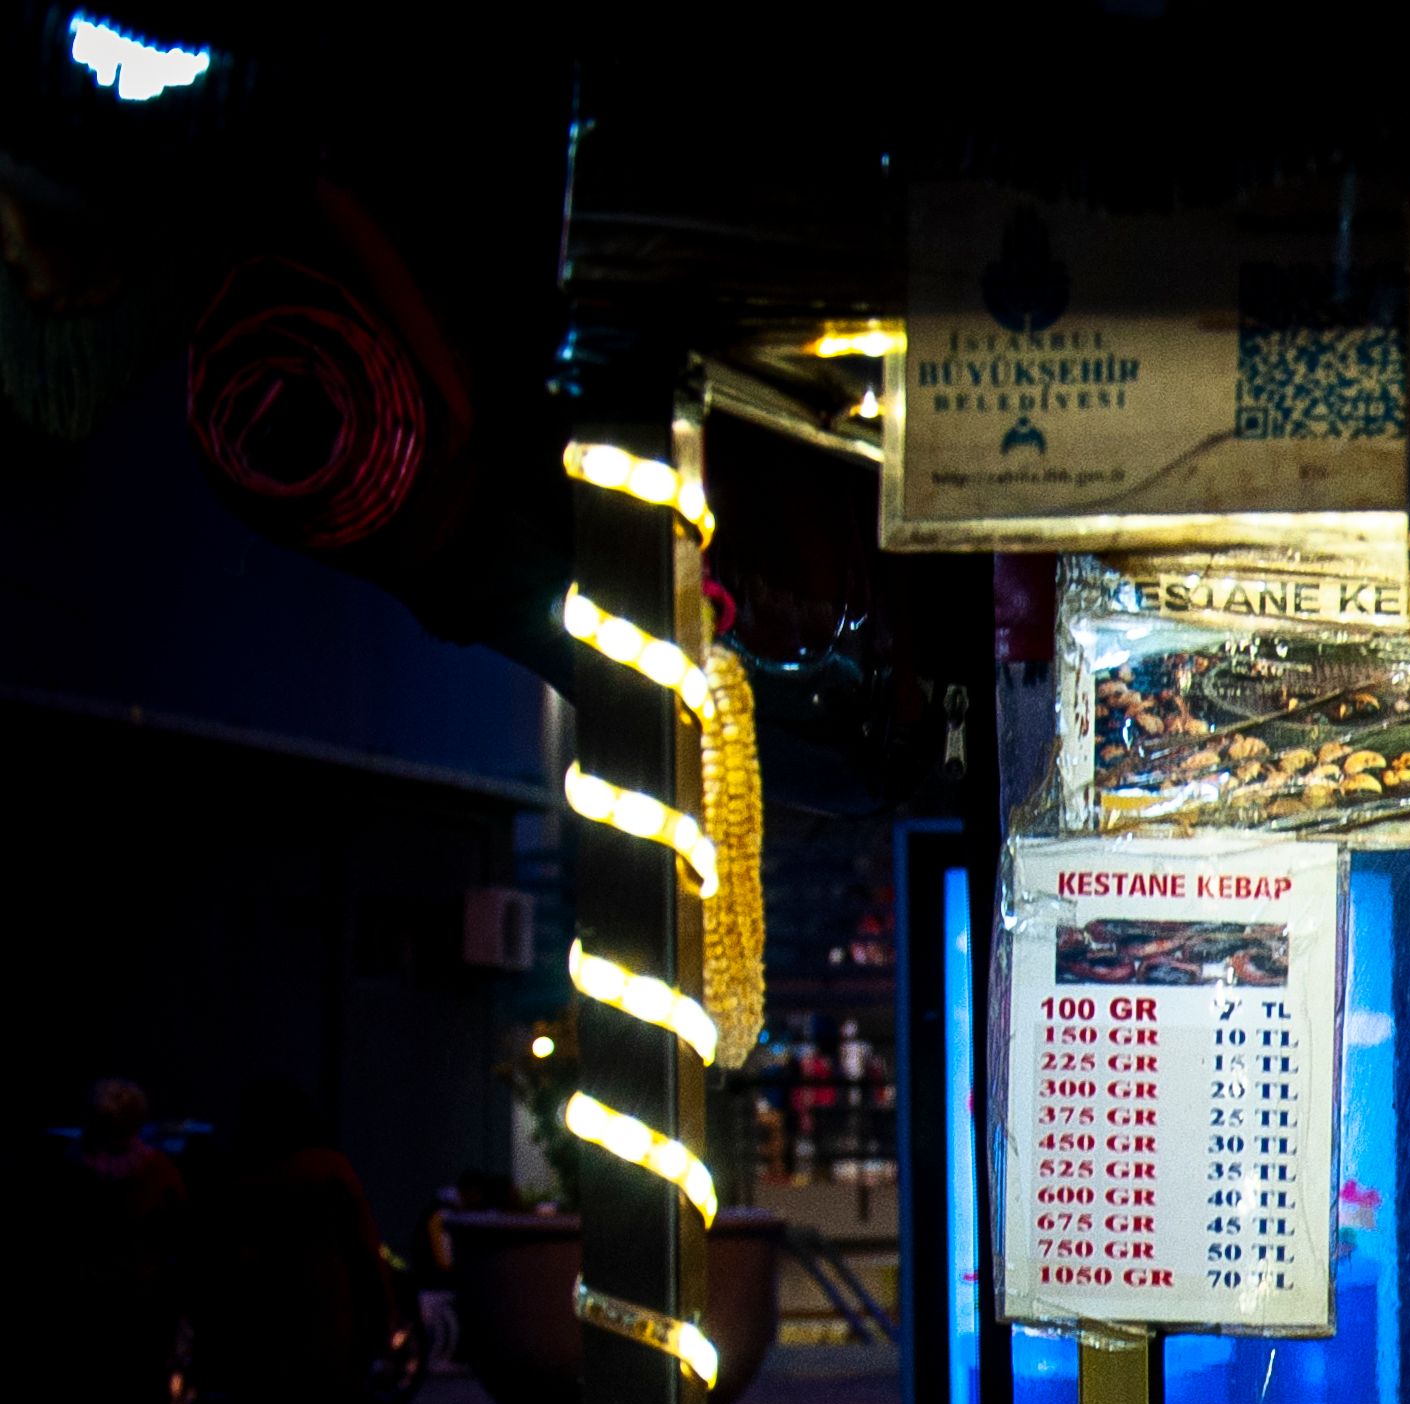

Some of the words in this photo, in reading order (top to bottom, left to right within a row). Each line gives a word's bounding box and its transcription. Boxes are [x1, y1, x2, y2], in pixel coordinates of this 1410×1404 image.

[1108, 579, 1320, 614] ESTANE
[1058, 871, 1186, 897] KESTANE
[1197, 874, 1292, 900] KEBAP
[1041, 997, 1095, 1020] 100
[1109, 997, 1157, 1021] GR
[1262, 1001, 1291, 1019] TL
[1045, 1026, 1097, 1044] 150
[1109, 1027, 1158, 1045] GR
[1215, 1028, 1246, 1045] 10
[1256, 1029, 1298, 1048] TL
[1040, 1052, 1095, 1071] 225
[1108, 1053, 1157, 1072] GR
[1256, 1054, 1298, 1074] TL
[1039, 1079, 1096, 1098] 300
[1107, 1080, 1157, 1099] GR
[1211, 1081, 1245, 1099] 20
[1255, 1081, 1297, 1100] TL
[1038, 1105, 1094, 1125] 375
[1106, 1107, 1157, 1126] GR
[1210, 1108, 1244, 1127] 25
[1255, 1108, 1297, 1128] TL
[1038, 1132, 1095, 1151] 450
[1106, 1134, 1157, 1153] GR
[1208, 1135, 1244, 1154] 30
[1254, 1135, 1297, 1155] TL
[1039, 1159, 1094, 1178] 525
[1105, 1161, 1156, 1180] GR
[1207, 1161, 1242, 1181] 35
[1253, 1162, 1296, 1182] TL
[1037, 1186, 1094, 1205] 600
[1105, 1187, 1156, 1206] GR
[1207, 1189, 1242, 1207] 40
[1253, 1190, 1296, 1209] TL
[1037, 1212, 1093, 1232] 675
[1105, 1214, 1155, 1233] GR
[1206, 1216, 1241, 1235] 45
[1252, 1216, 1295, 1236] TL
[1037, 1239, 1093, 1258] 750
[1104, 1241, 1155, 1260] GR
[1207, 1243, 1242, 1262] 50
[1252, 1243, 1295, 1263] TL
[1040, 1266, 1112, 1285] 1050
[1123, 1267, 1174, 1288] GR
[1206, 1269, 1241, 1288] 70
